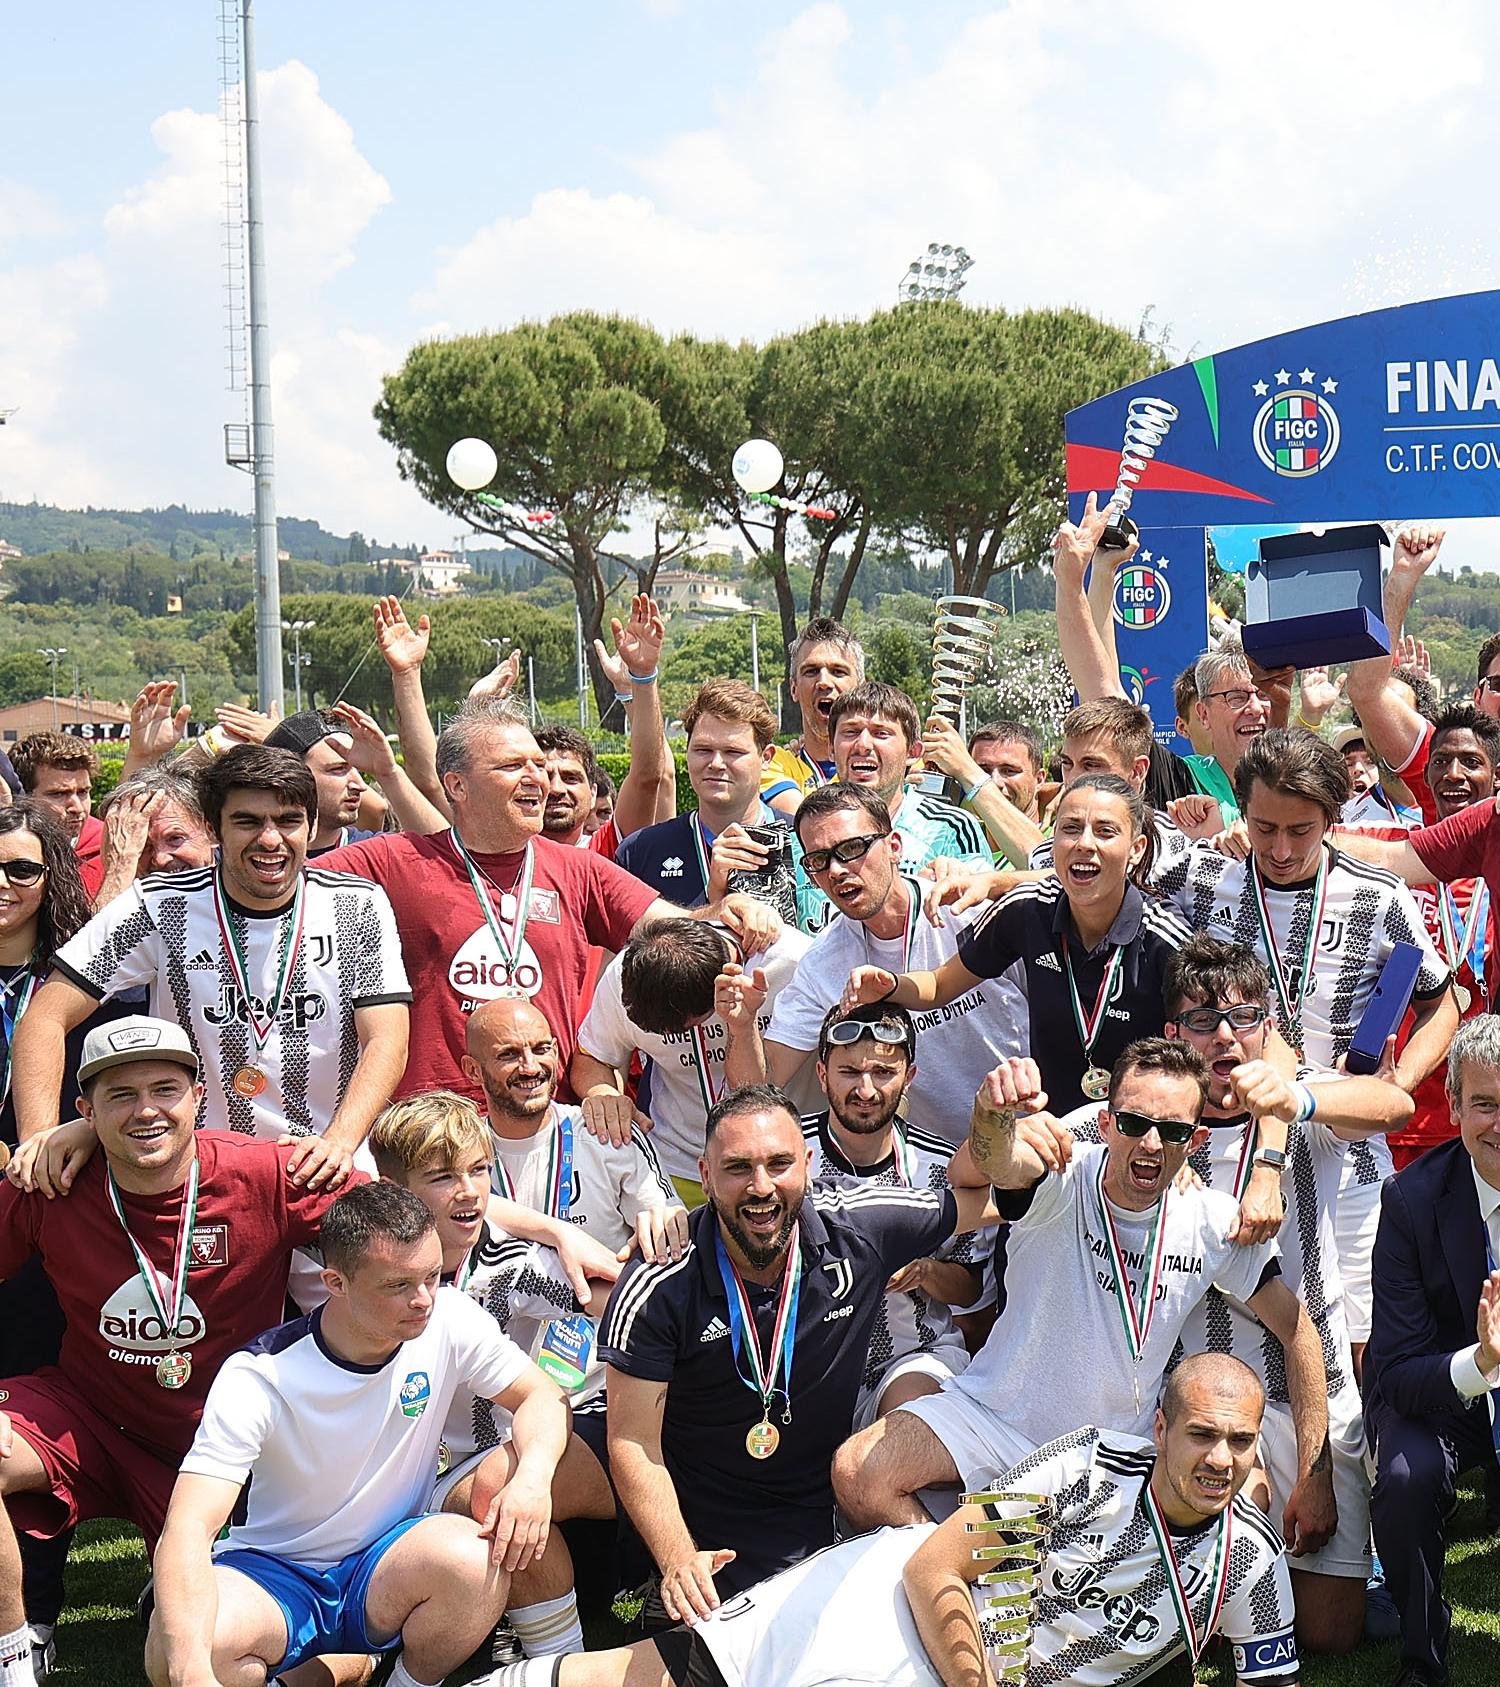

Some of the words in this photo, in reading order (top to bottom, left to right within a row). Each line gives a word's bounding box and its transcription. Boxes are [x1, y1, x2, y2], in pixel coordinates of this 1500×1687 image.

[1274, 419, 1318, 441] FIGC
[1385, 444, 1447, 473] C.T.F.
[1122, 587, 1155, 603] FIGC
[1209, 915, 1235, 929] adidas
[185, 959, 220, 971] adidas
[1034, 957, 1063, 973] adidas
[202, 984, 328, 1031] Jeep
[942, 990, 987, 1021] D'ITALIA
[823, 1304, 854, 1322] Jeep
[700, 1326, 732, 1343] adidas
[1050, 1563, 1160, 1645] Jeep
